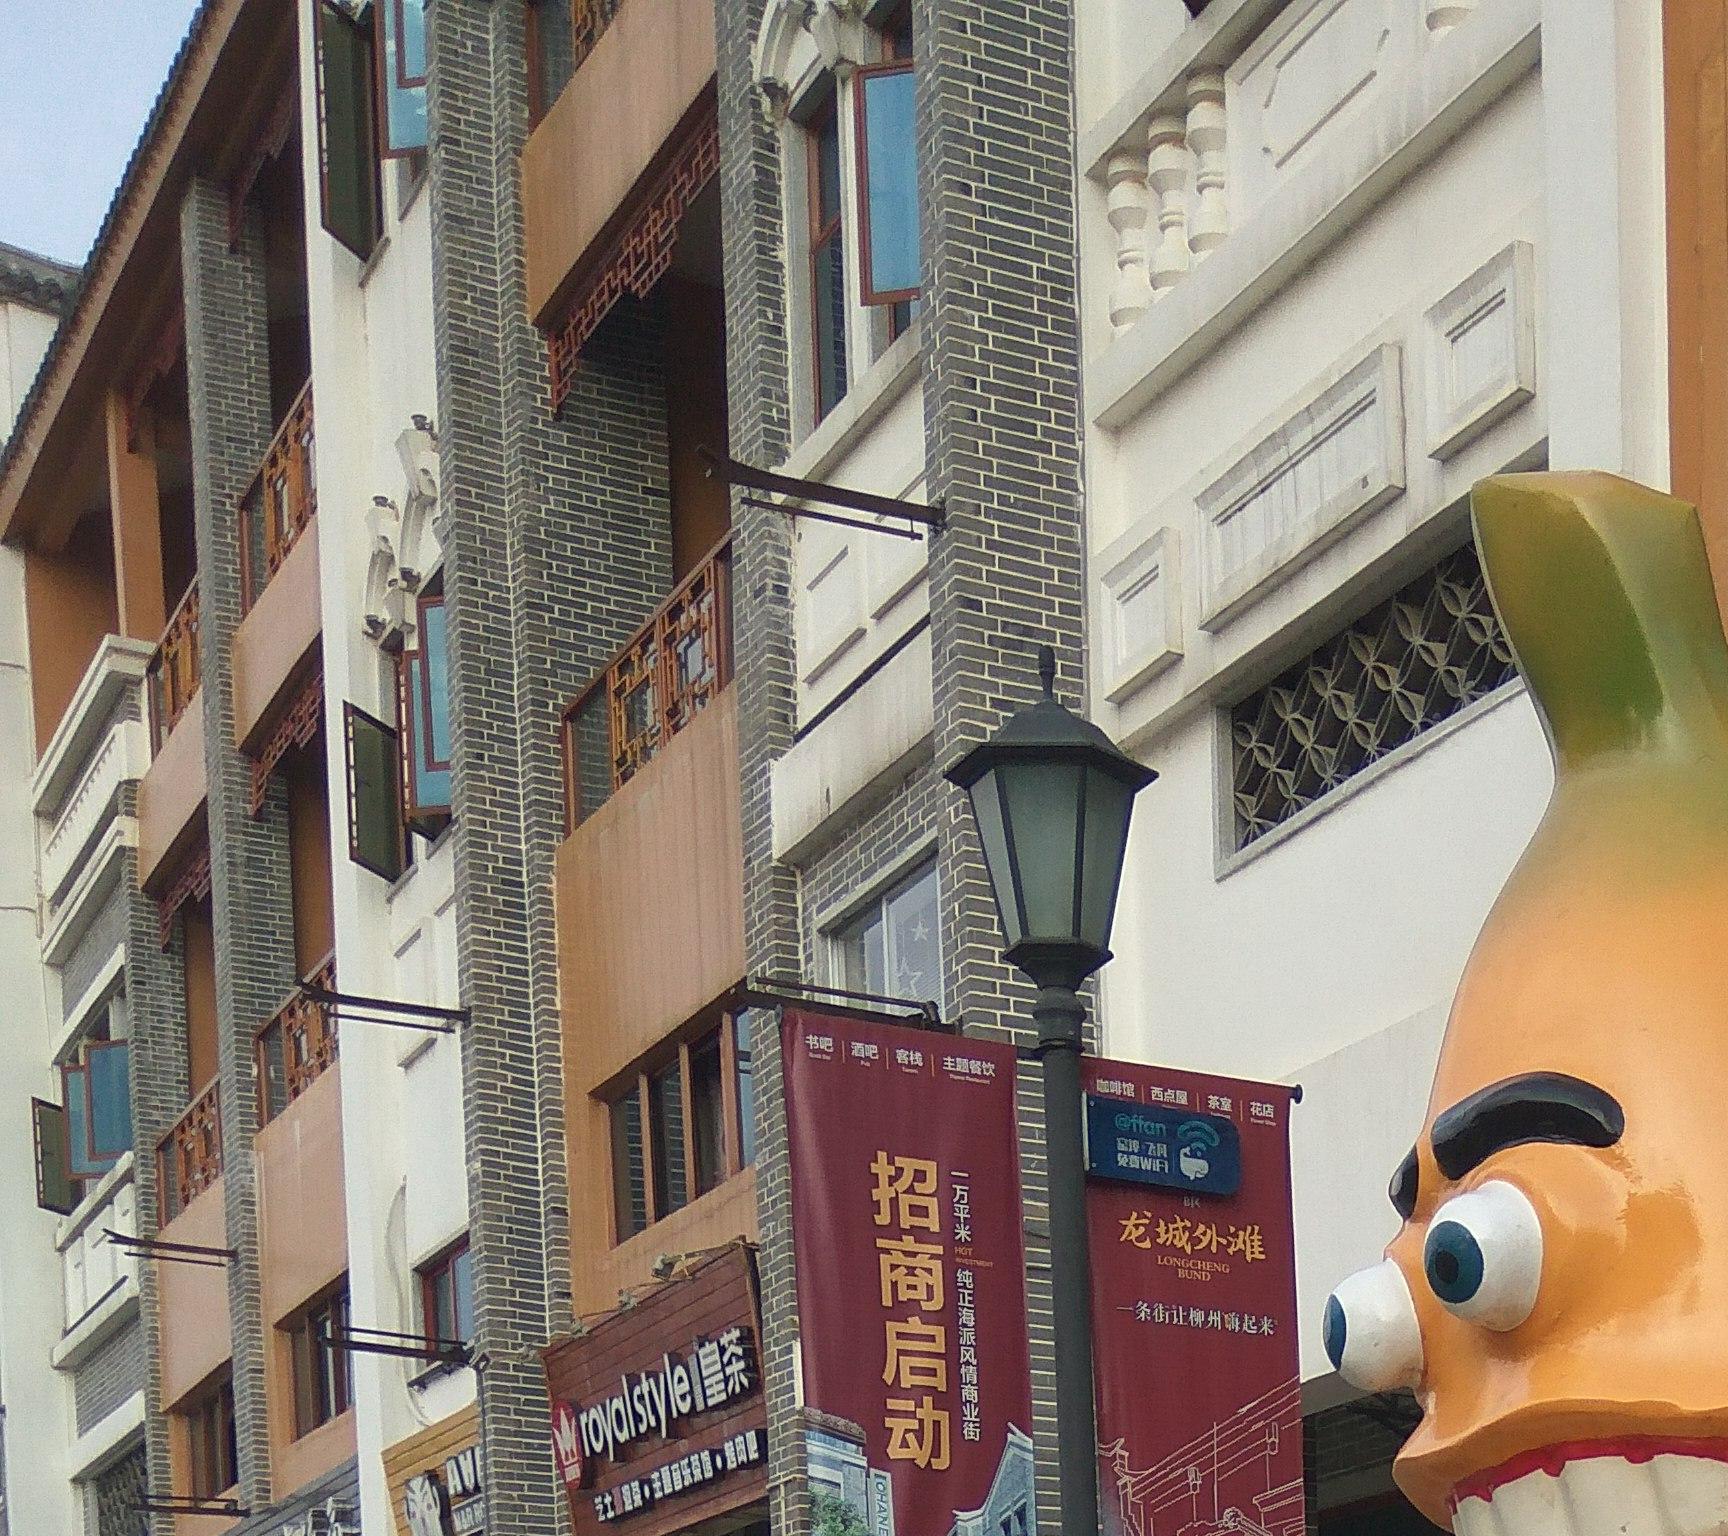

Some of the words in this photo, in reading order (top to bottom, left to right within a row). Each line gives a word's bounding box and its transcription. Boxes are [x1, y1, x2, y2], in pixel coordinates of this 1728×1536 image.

[805, 1034, 834, 1053] 书吧
[851, 1041, 879, 1060] 酒吧
[896, 1048, 924, 1067] 客栈
[942, 1055, 996, 1078] 主题餐饮
[1096, 1078, 1135, 1098] 咖啡馆
[1150, 1086, 1189, 1105] 西点屋
[1207, 1094, 1233, 1112] 茶室
[1249, 1101, 1275, 1119] 花店
[950, 1171, 972, 1243] 一万平米
[1118, 1210, 1267, 1263] 龙城外滩
[1157, 1254, 1231, 1274] LONGCHENG
[1178, 1269, 1211, 1282] BUND
[870, 1150, 951, 1472] 招商启动
[1116, 1300, 1276, 1336] 一条街让柳州嗨起来
[956, 1268, 981, 1442] 纯正海派风情商业街
[579, 1352, 692, 1462] royalstyle
[699, 1328, 749, 1407] 皇茶
